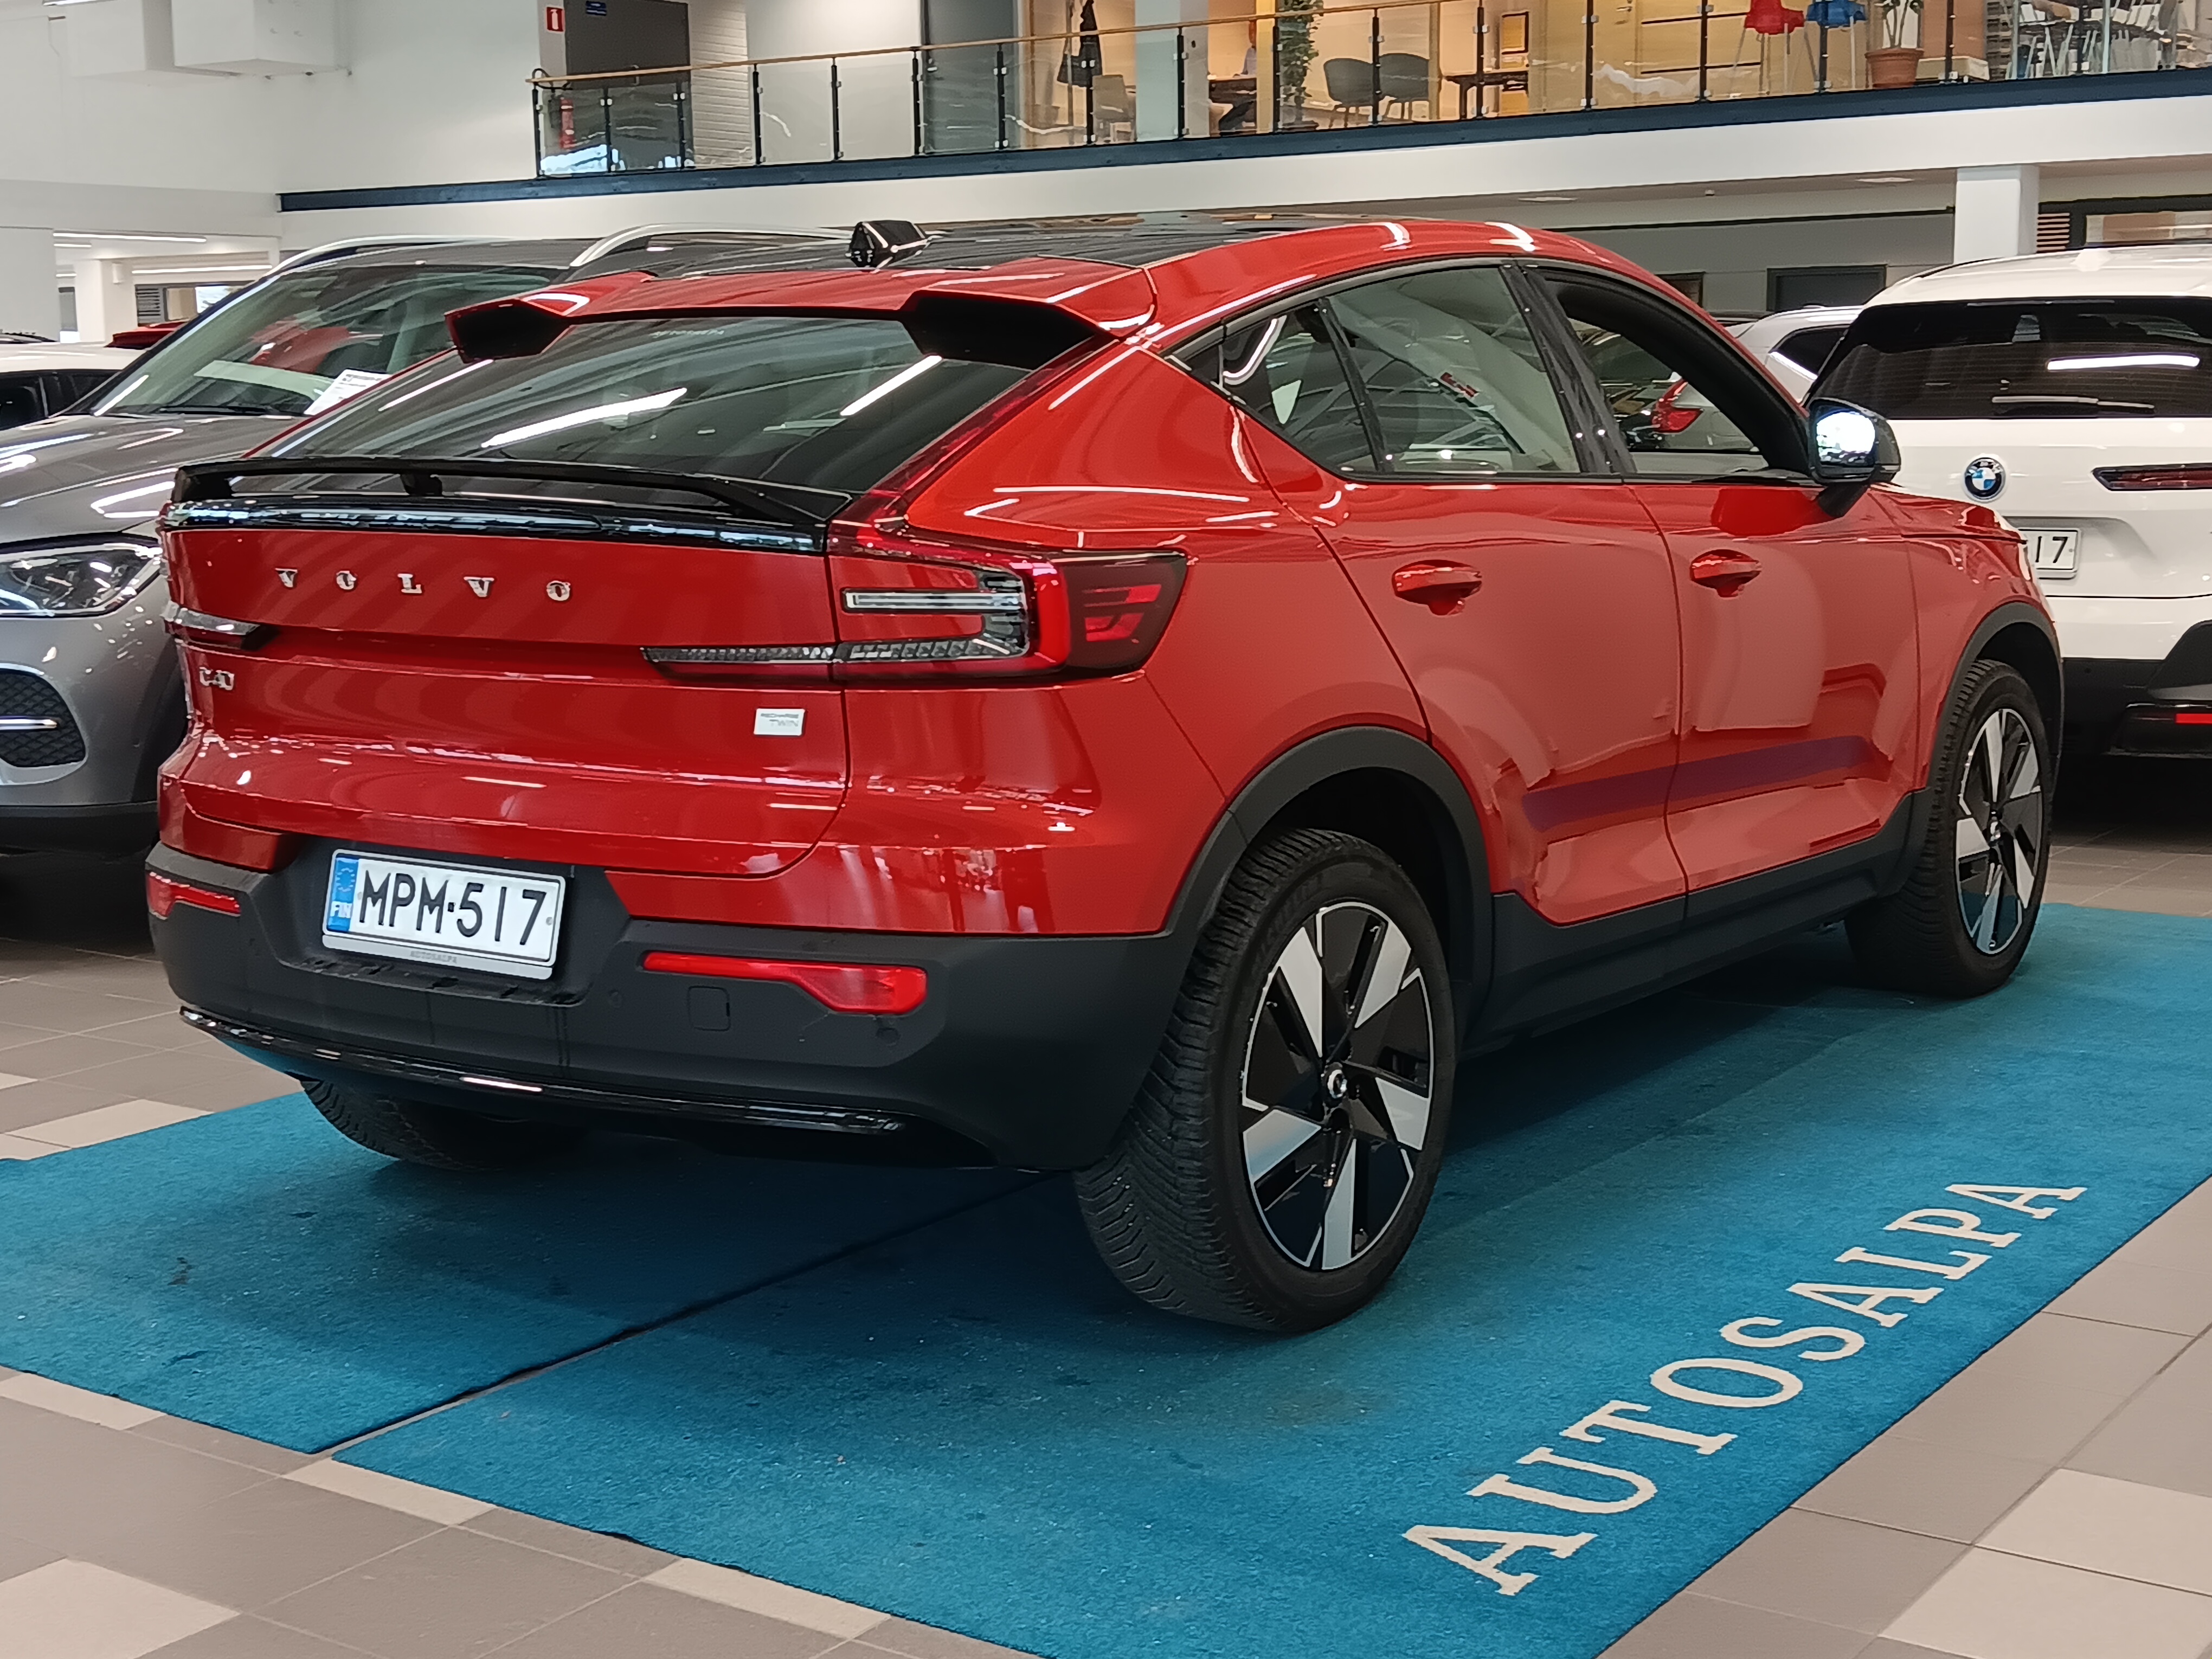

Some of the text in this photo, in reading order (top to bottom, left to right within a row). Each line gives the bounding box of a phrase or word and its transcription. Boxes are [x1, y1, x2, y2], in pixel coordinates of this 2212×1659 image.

[275, 568, 570, 601] VOLVO
[331, 901, 352, 918] FIN
[359, 870, 546, 945] MPM-517
[1401, 1183, 2087, 1596] AUTOSALPA
